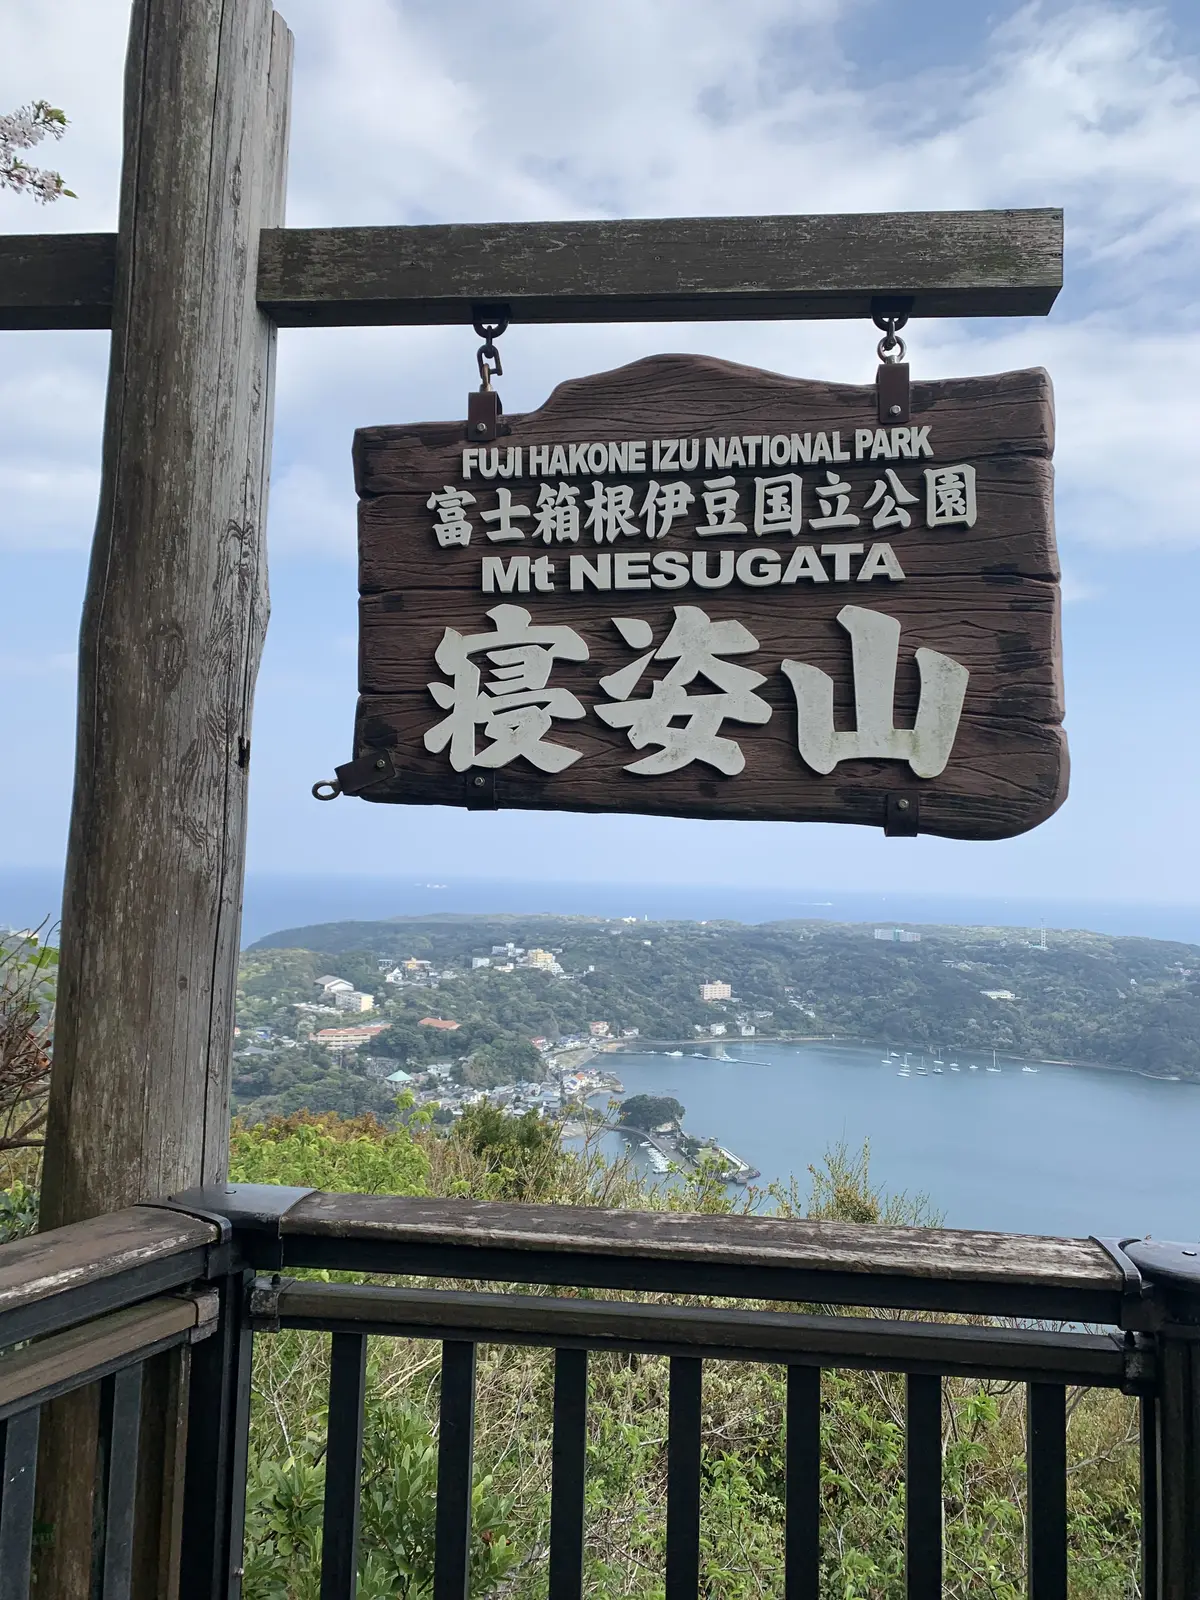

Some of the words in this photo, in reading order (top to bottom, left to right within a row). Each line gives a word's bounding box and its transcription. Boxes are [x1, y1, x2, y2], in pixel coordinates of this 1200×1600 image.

[462, 446, 523, 479] FUJI
[530, 441, 646, 476] HAKONE
[652, 438, 700, 471] IZU
[704, 431, 850, 469] NATIONAL
[855, 426, 933, 460] PARK
[427, 463, 977, 548] 富士箱根伊豆国立公園
[482, 554, 556, 593] Mt
[570, 542, 905, 591] NESUGATA
[423, 604, 970, 779] 寝姿山
